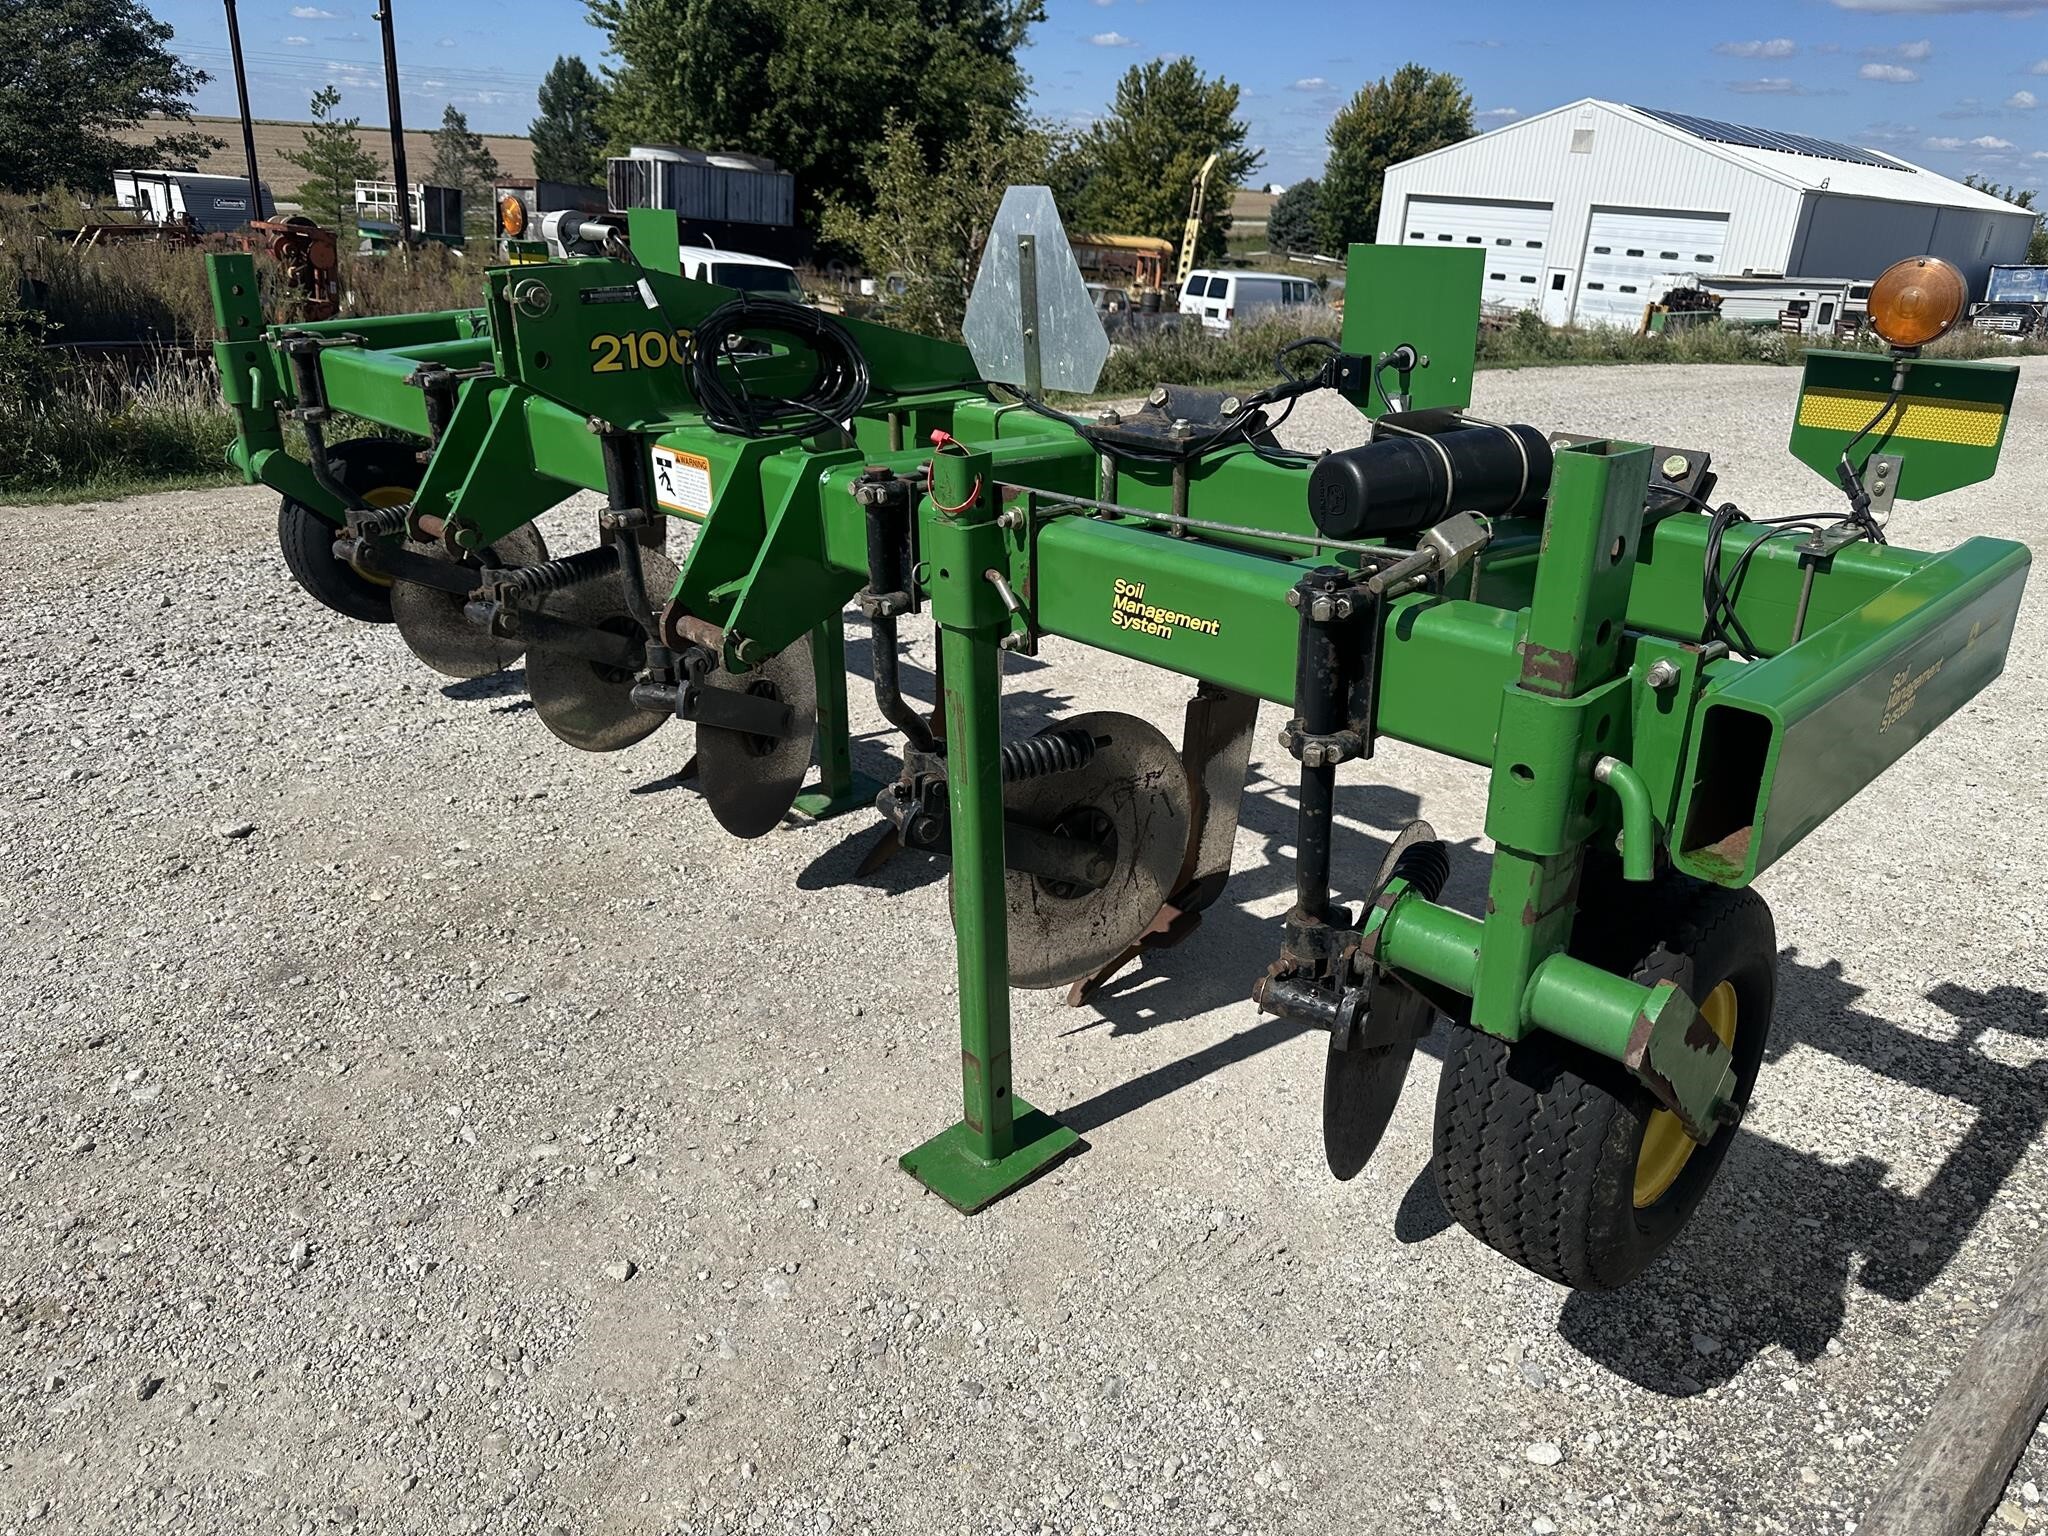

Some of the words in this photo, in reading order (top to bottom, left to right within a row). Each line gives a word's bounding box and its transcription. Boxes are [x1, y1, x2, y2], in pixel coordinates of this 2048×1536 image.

[680, 456, 707, 470] WARNING
[1113, 578, 1145, 599] Soil
[1111, 610, 1173, 640] System
[1112, 594, 1220, 636] Management
